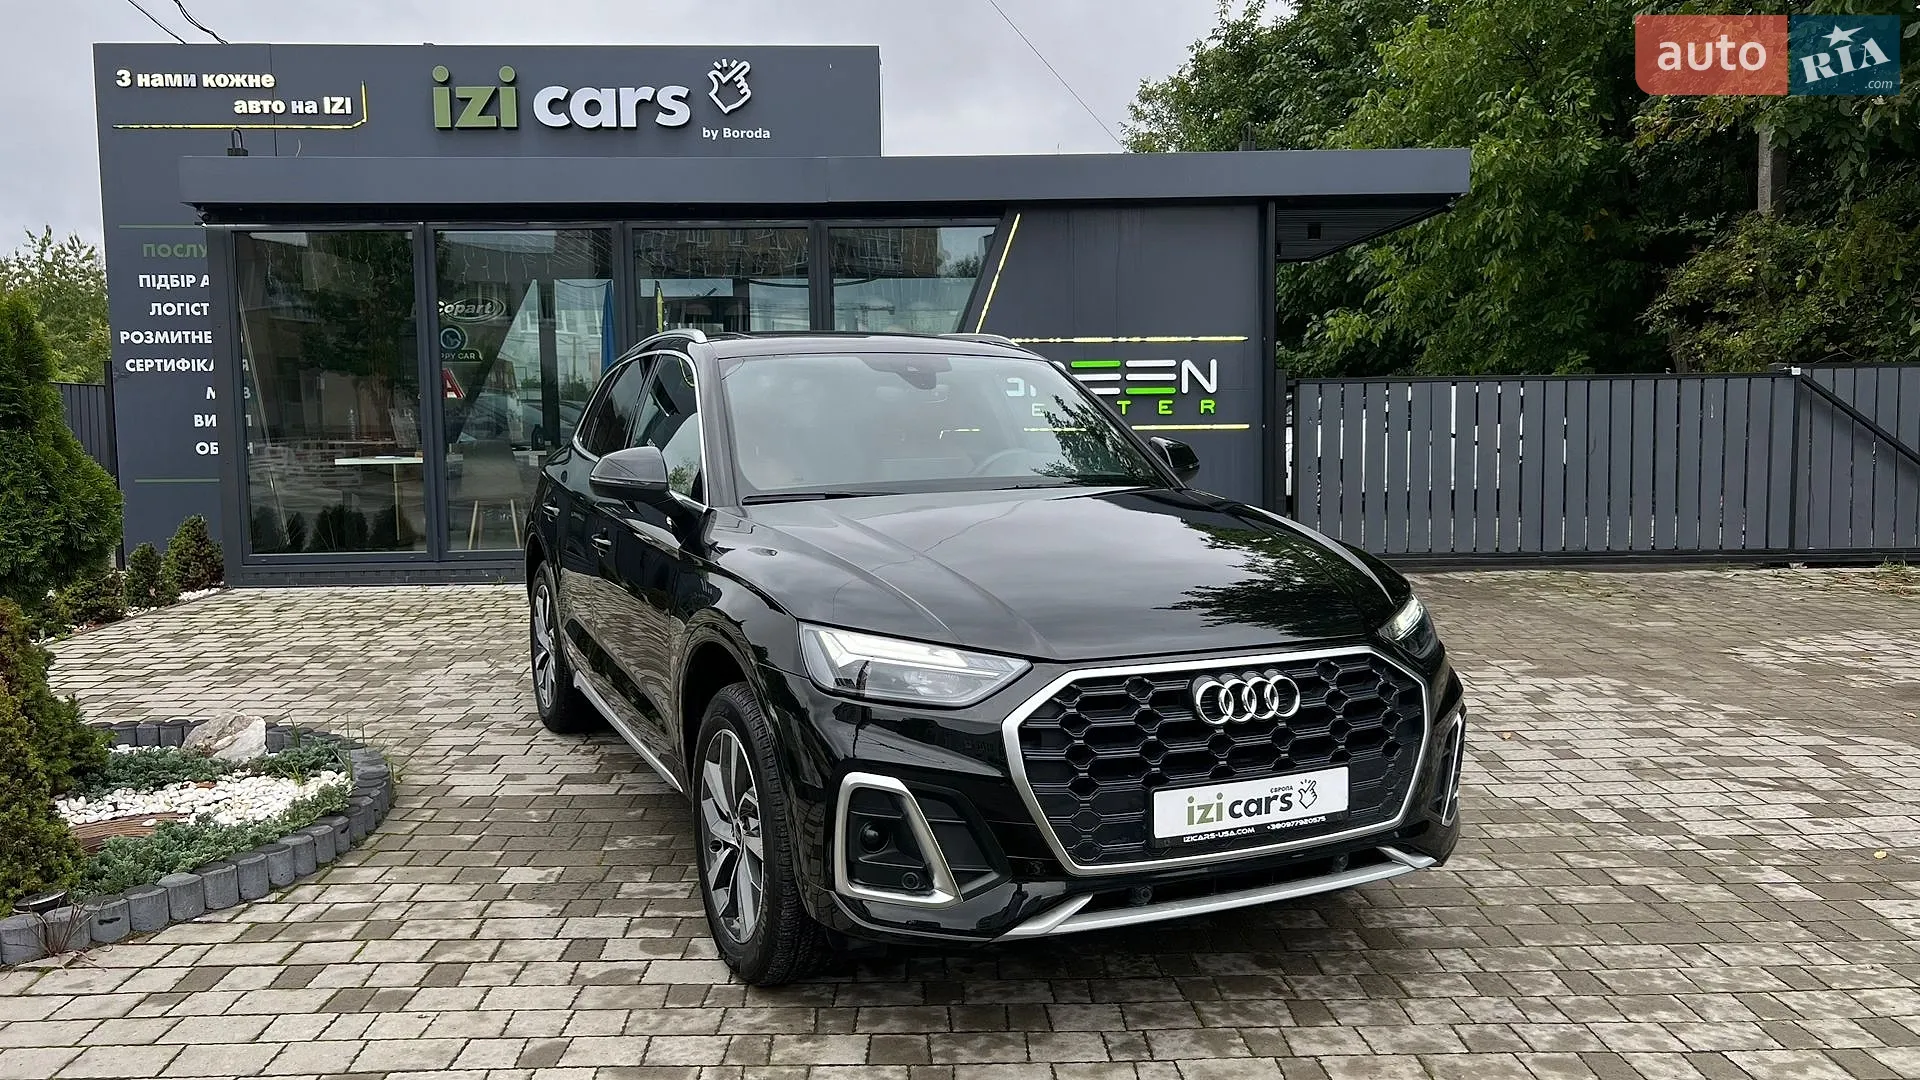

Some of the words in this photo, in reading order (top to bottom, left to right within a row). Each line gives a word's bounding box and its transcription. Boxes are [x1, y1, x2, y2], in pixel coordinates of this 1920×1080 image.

[137, 72, 197, 88] нами
[202, 72, 276, 88] кожне
[433, 65, 518, 129] izi
[533, 85, 691, 129] cars
[233, 98, 286, 115] авто
[291, 98, 318, 115] на
[323, 96, 353, 115] IZI
[702, 127, 719, 141] by
[722, 127, 771, 139] Boroda
[143, 243, 208, 258] ПОСЛУ
[138, 274, 197, 290] ПІДБІР
[149, 302, 210, 316] ЛОГІСТ
[119, 330, 213, 344] РОЗМИТНЕ
[458, 352, 476, 360] CAR
[1187, 792, 1223, 825] izi
[1228, 792, 1293, 819] cars
[1183, 827, 1256, 843] IZICARS-USA.COM
